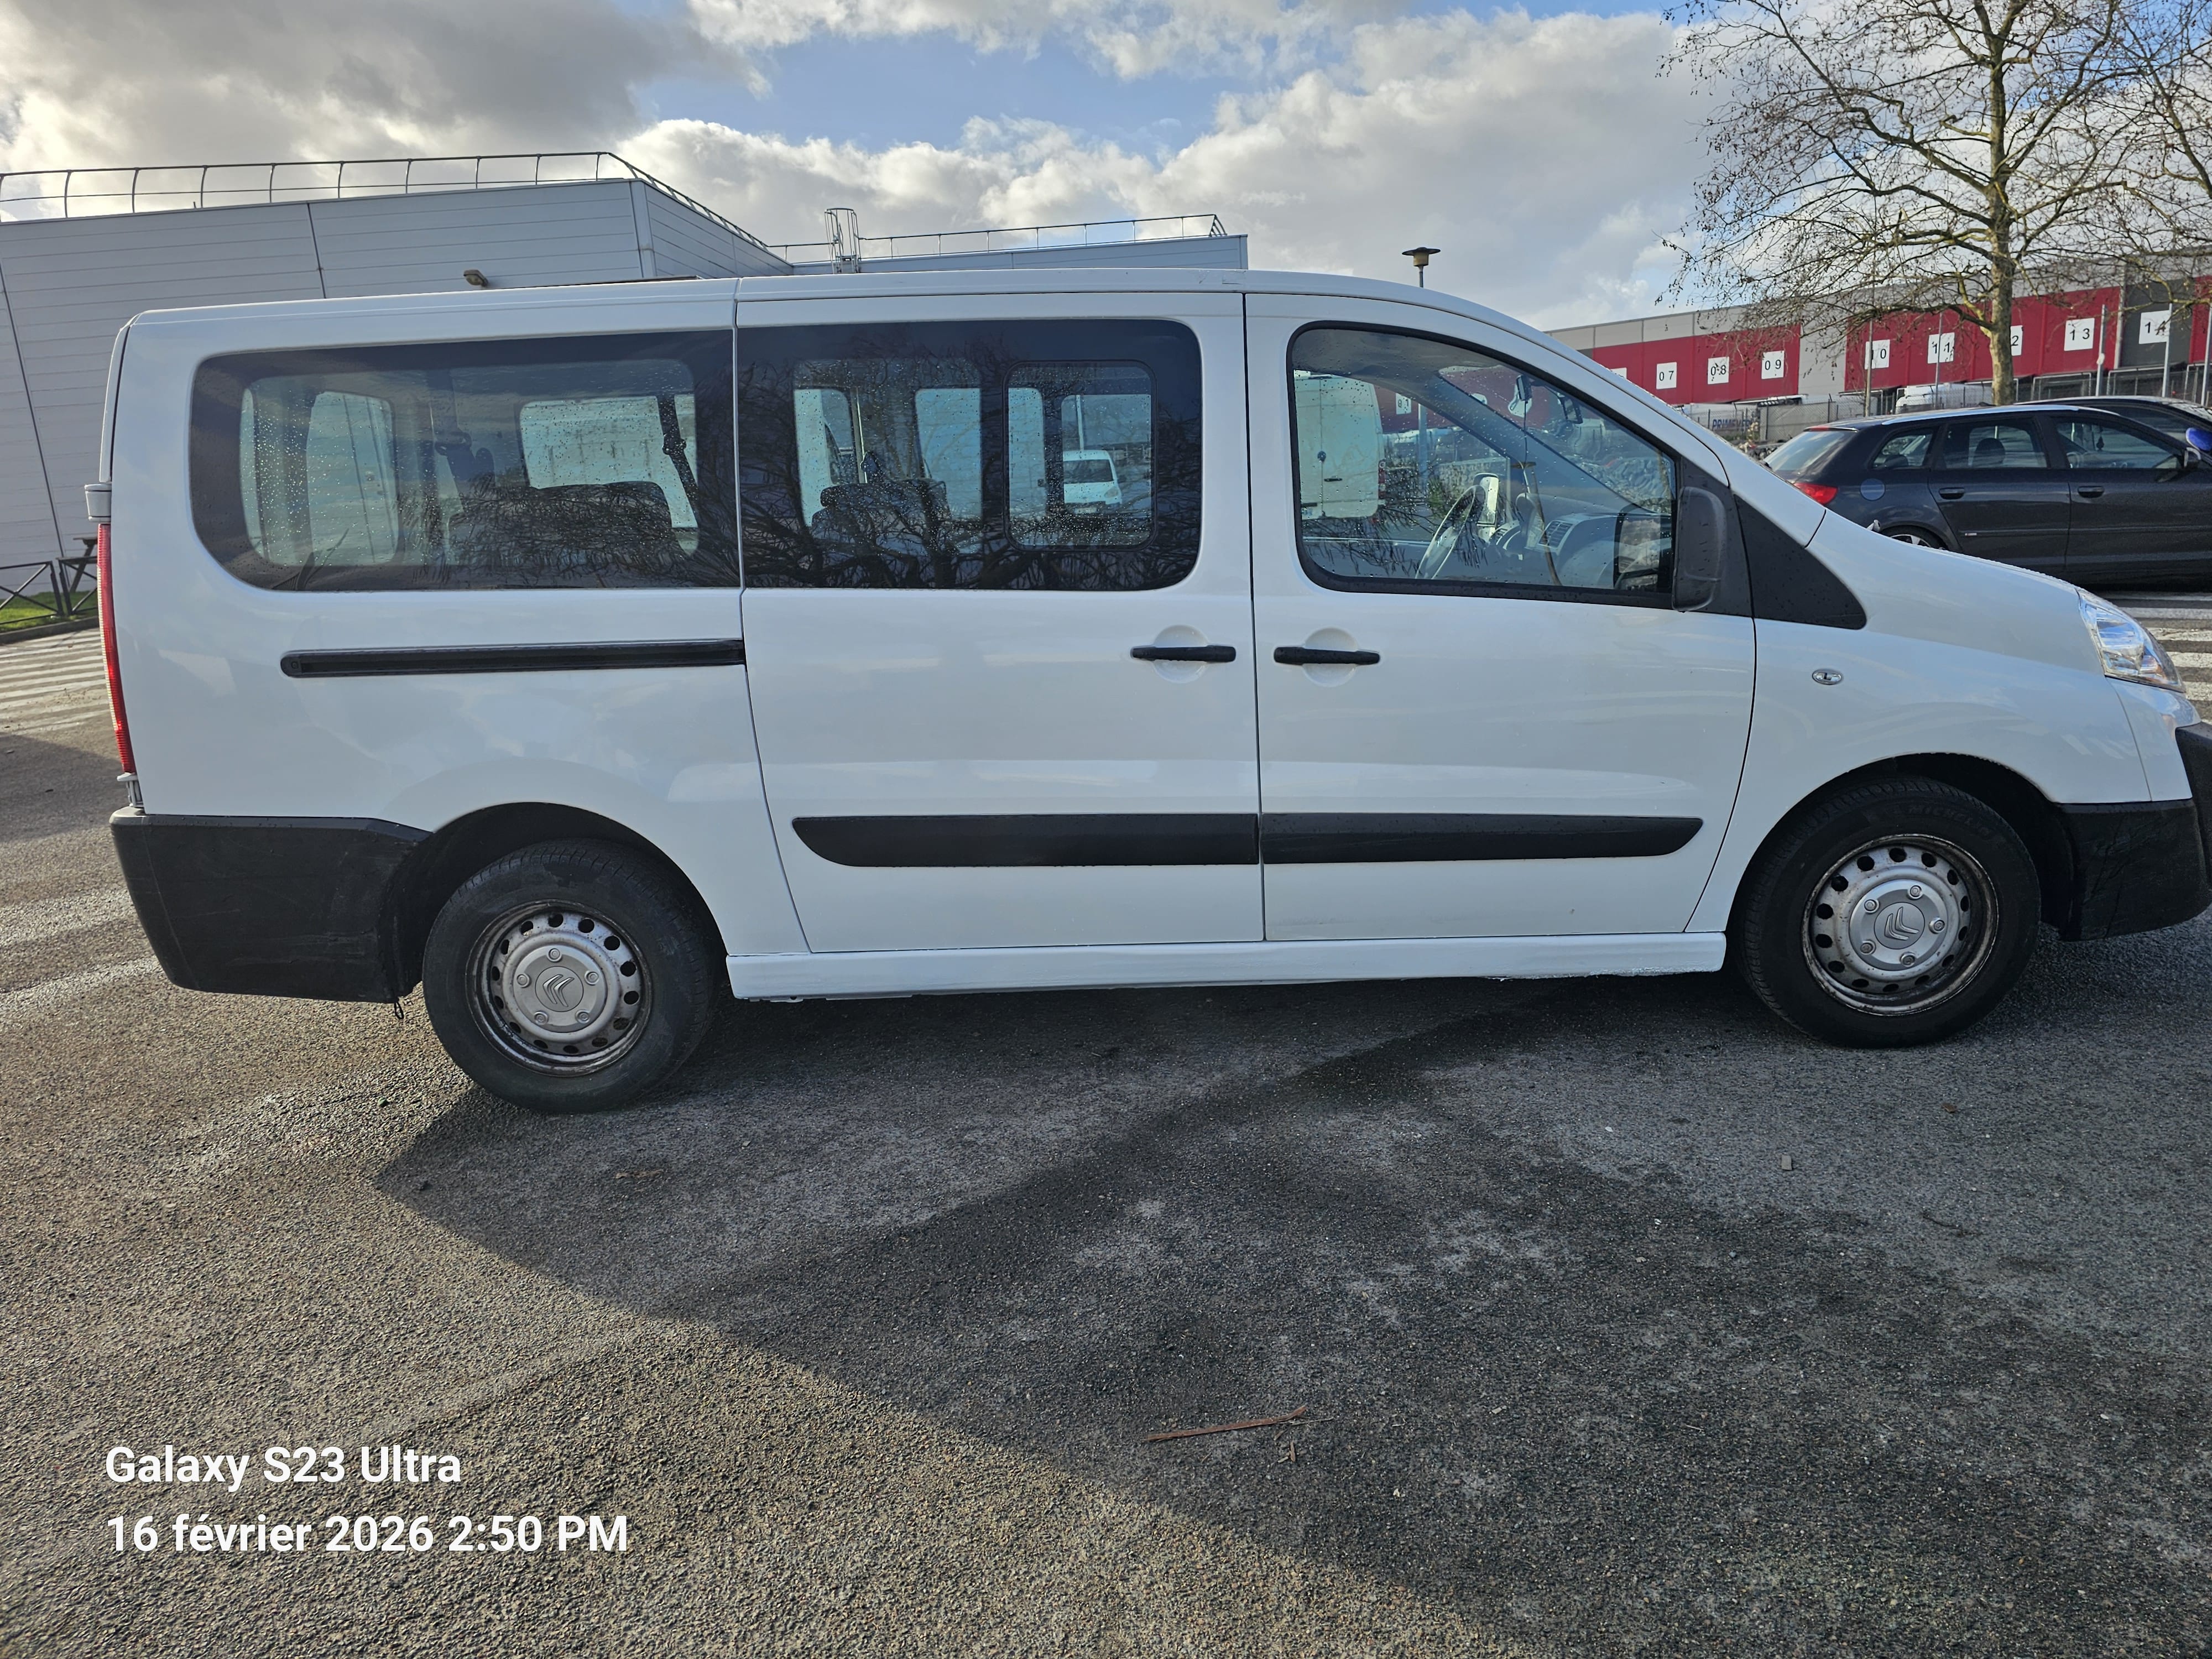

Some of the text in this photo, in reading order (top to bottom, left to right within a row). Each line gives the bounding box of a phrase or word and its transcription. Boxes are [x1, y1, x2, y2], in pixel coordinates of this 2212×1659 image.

[2070, 328, 2090, 341] 13
[1932, 342, 1950, 354] 11
[1710, 365, 1726, 376] 08
[1765, 359, 1781, 371] 09
[1659, 371, 1674, 382] 07
